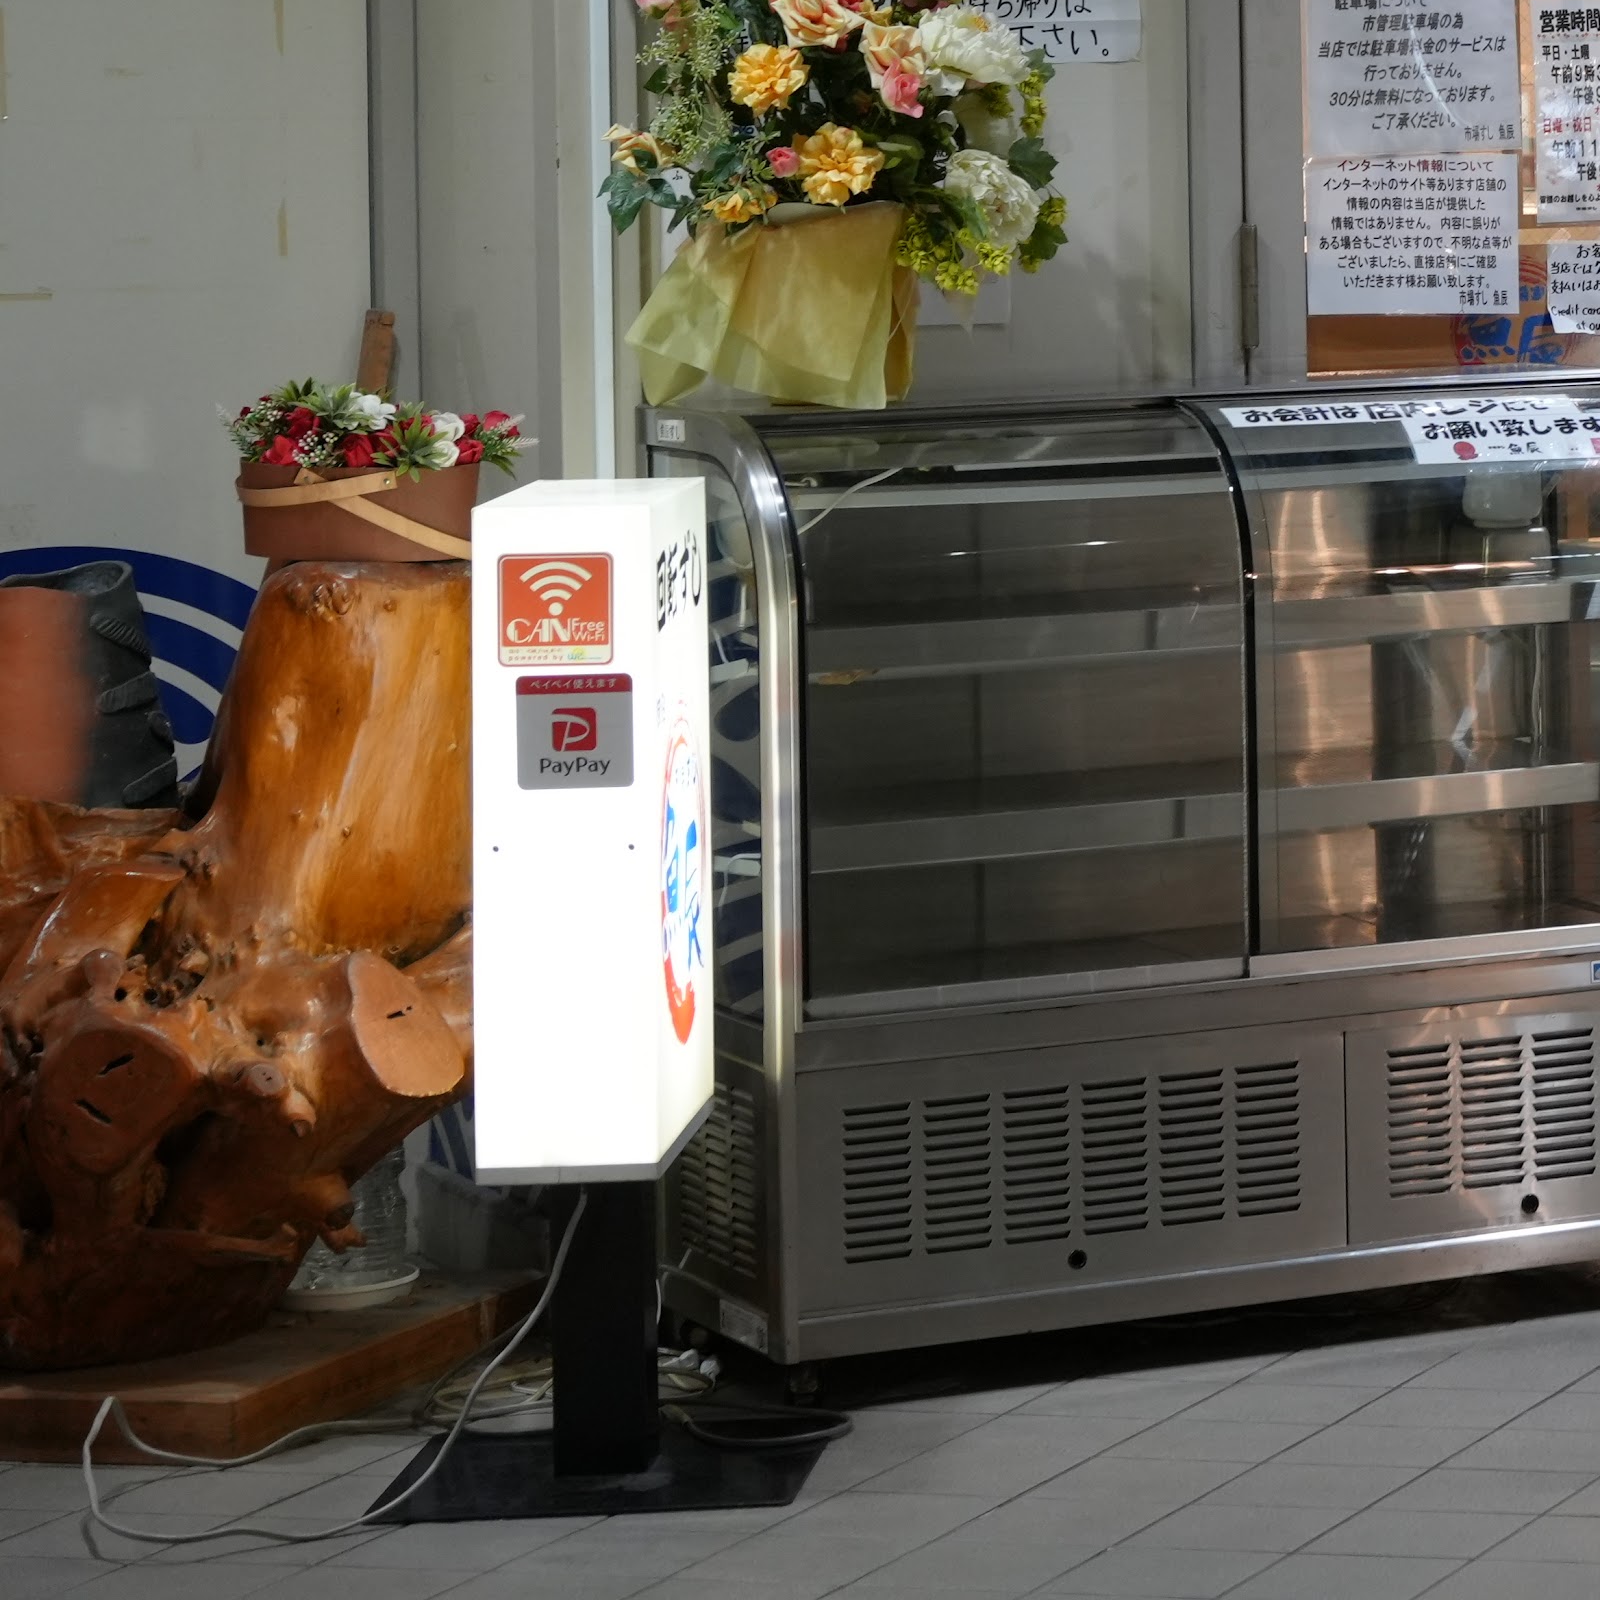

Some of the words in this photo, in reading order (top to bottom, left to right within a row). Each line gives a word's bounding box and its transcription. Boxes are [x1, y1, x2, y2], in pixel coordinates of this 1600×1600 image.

[1362, 12, 1464, 32] 市管理駐車場の為
[1318, 36, 1506, 58] 当店では駐車場料金のサービスは
[1542, 44, 1589, 60] 平日・土曜
[1364, 63, 1462, 81] 行っておりません。
[1330, 85, 1495, 106] 30分は無料になっております。
[1372, 113, 1456, 130] ご了承ください。
[1543, 117, 1592, 133] 日曜・祝日
[1337, 159, 1494, 172] インターネット情報について
[1323, 178, 1507, 192] インターネットのサイト等あります店舗の
[1347, 197, 1486, 211] 情報の内容は当店が提供した
[1331, 216, 1432, 230] 情報ではありません。
[1440, 216, 1500, 230] 内容に誤りが
[1337, 255, 1497, 269] ございましたら、直接店舗にご確認
[1343, 274, 1491, 288] いただきます様お願い致します。
[1551, 304, 1579, 316] Credit
[1576, 320, 1586, 331] at
[1508, 442, 1543, 456] 魚辰
[657, 528, 702, 632] 回転ずし
[506, 617, 571, 644] CAN
[572, 618, 605, 632] Free
[572, 631, 605, 643] Wi-Fi
[530, 678, 617, 690] ペイペイ使えます
[540, 756, 611, 777] PayPay
